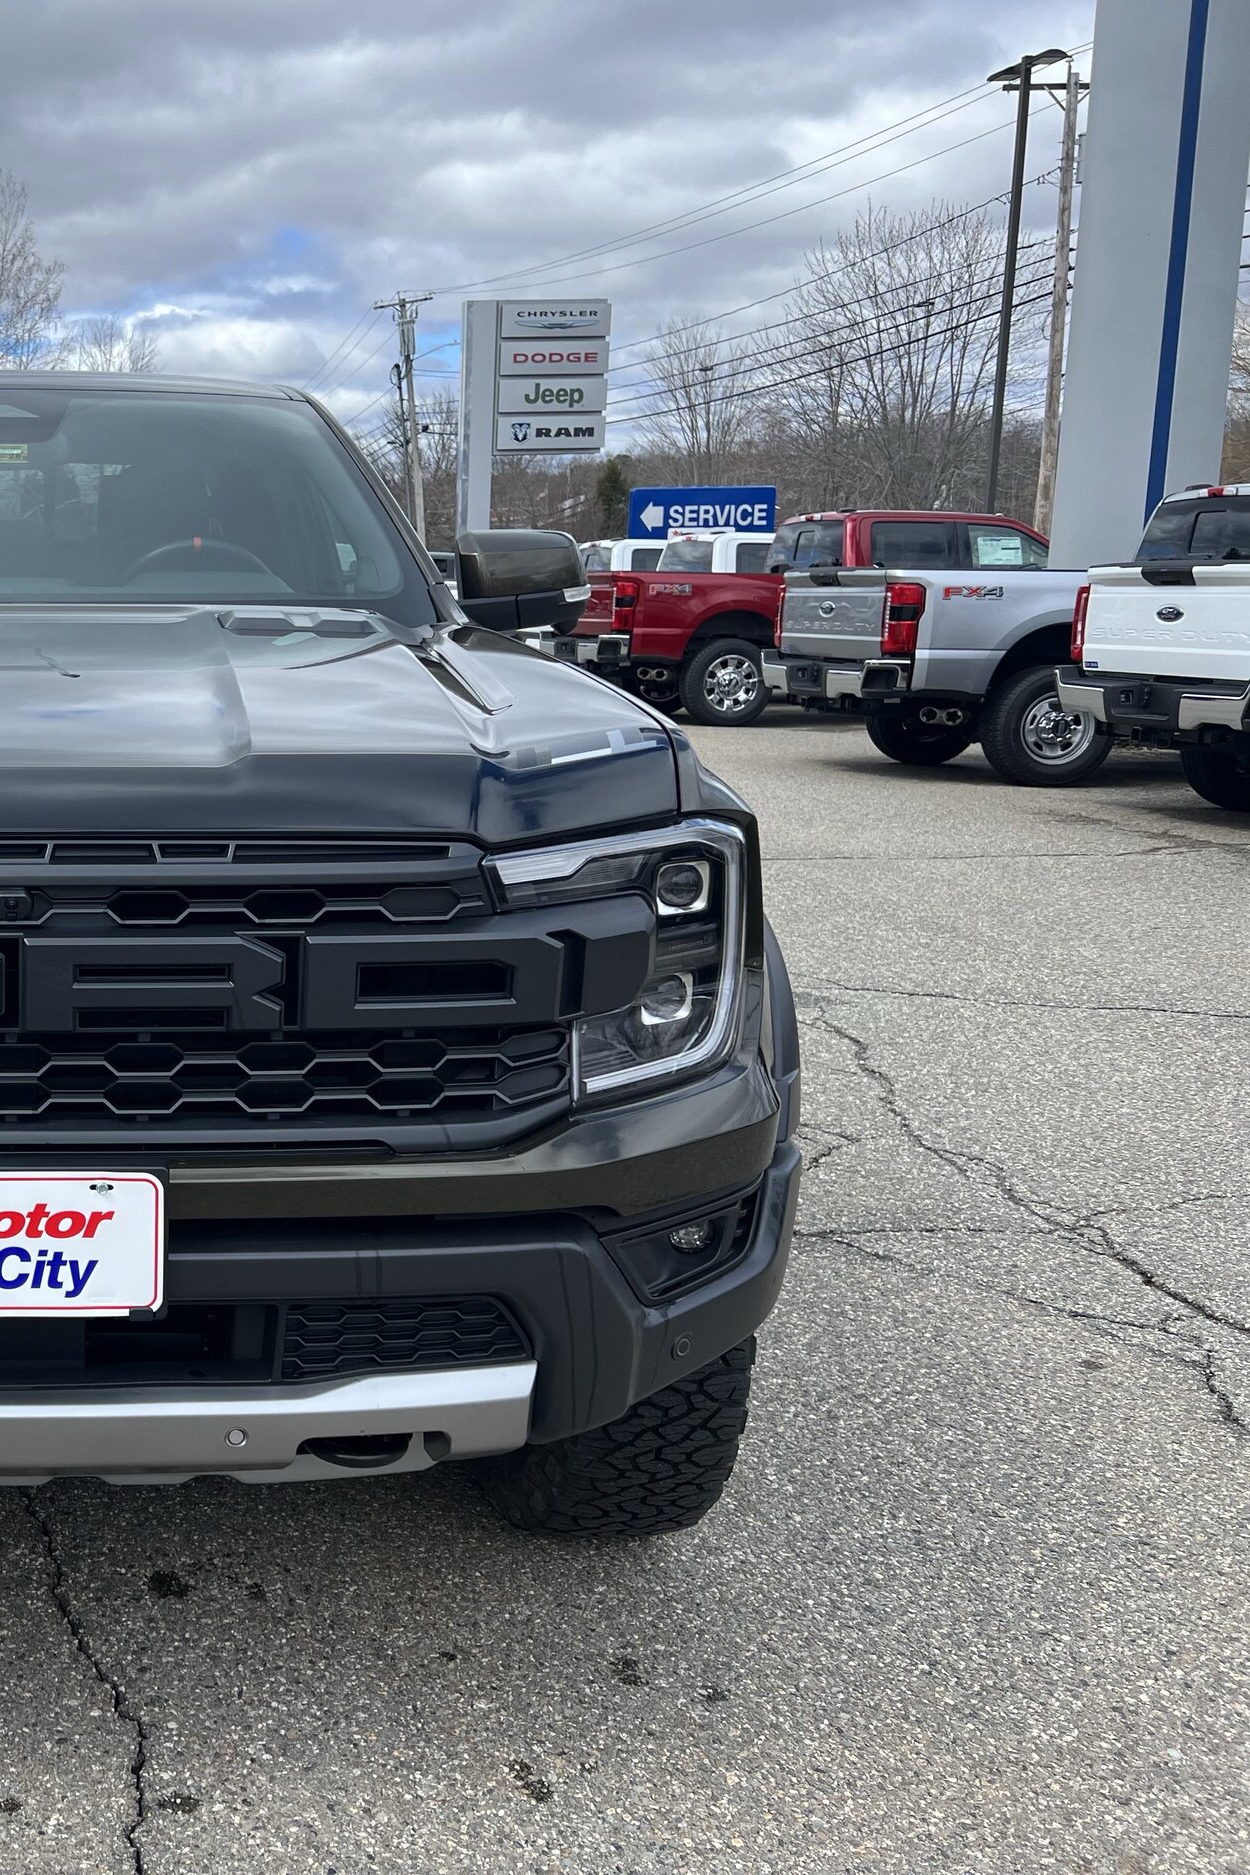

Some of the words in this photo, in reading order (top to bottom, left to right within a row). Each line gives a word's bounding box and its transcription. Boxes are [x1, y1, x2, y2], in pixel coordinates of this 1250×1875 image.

[516, 310, 598, 318] CHRYSLER
[512, 351, 598, 364] DODGE
[524, 383, 584, 408] Jeep
[535, 426, 595, 438] RAM
[668, 504, 768, 527] SERVICE
[943, 586, 1004, 598] FX4
[1092, 627, 1175, 641] SUPER
